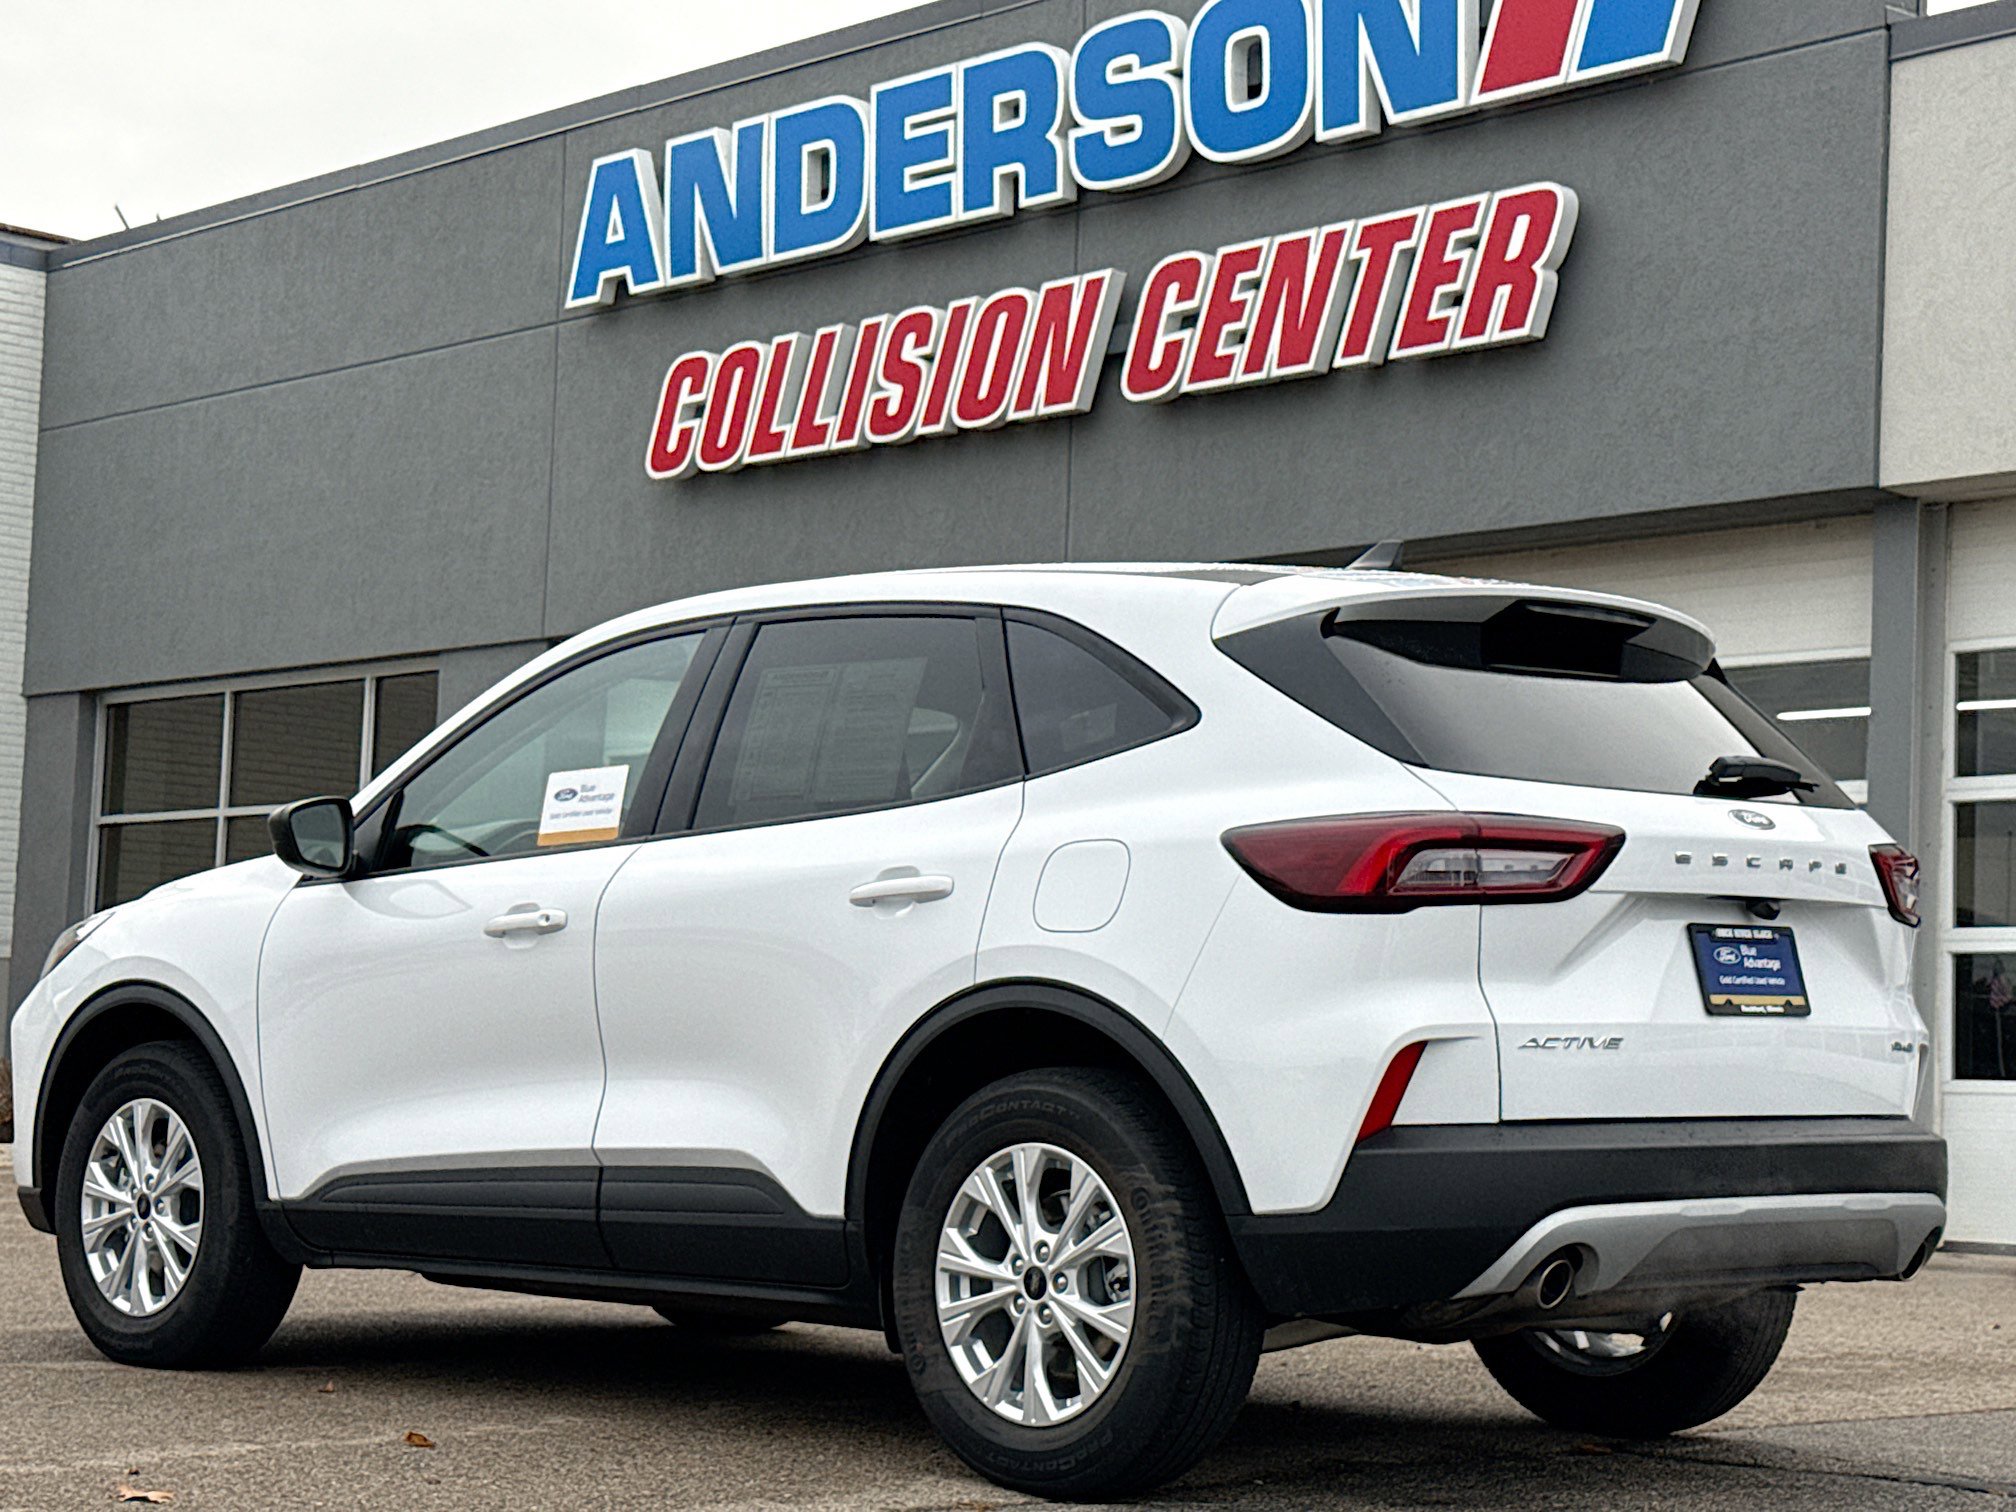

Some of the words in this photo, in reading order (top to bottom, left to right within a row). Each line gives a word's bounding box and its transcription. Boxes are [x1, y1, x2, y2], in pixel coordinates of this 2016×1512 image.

[565, 0, 1480, 310] ANDERSON
[645, 268, 1126, 480] COLLISION
[1120, 182, 1579, 402] CENTER
[1675, 851, 1847, 875] ESCAPE
[1518, 1037, 1624, 1049] ACTIVE
